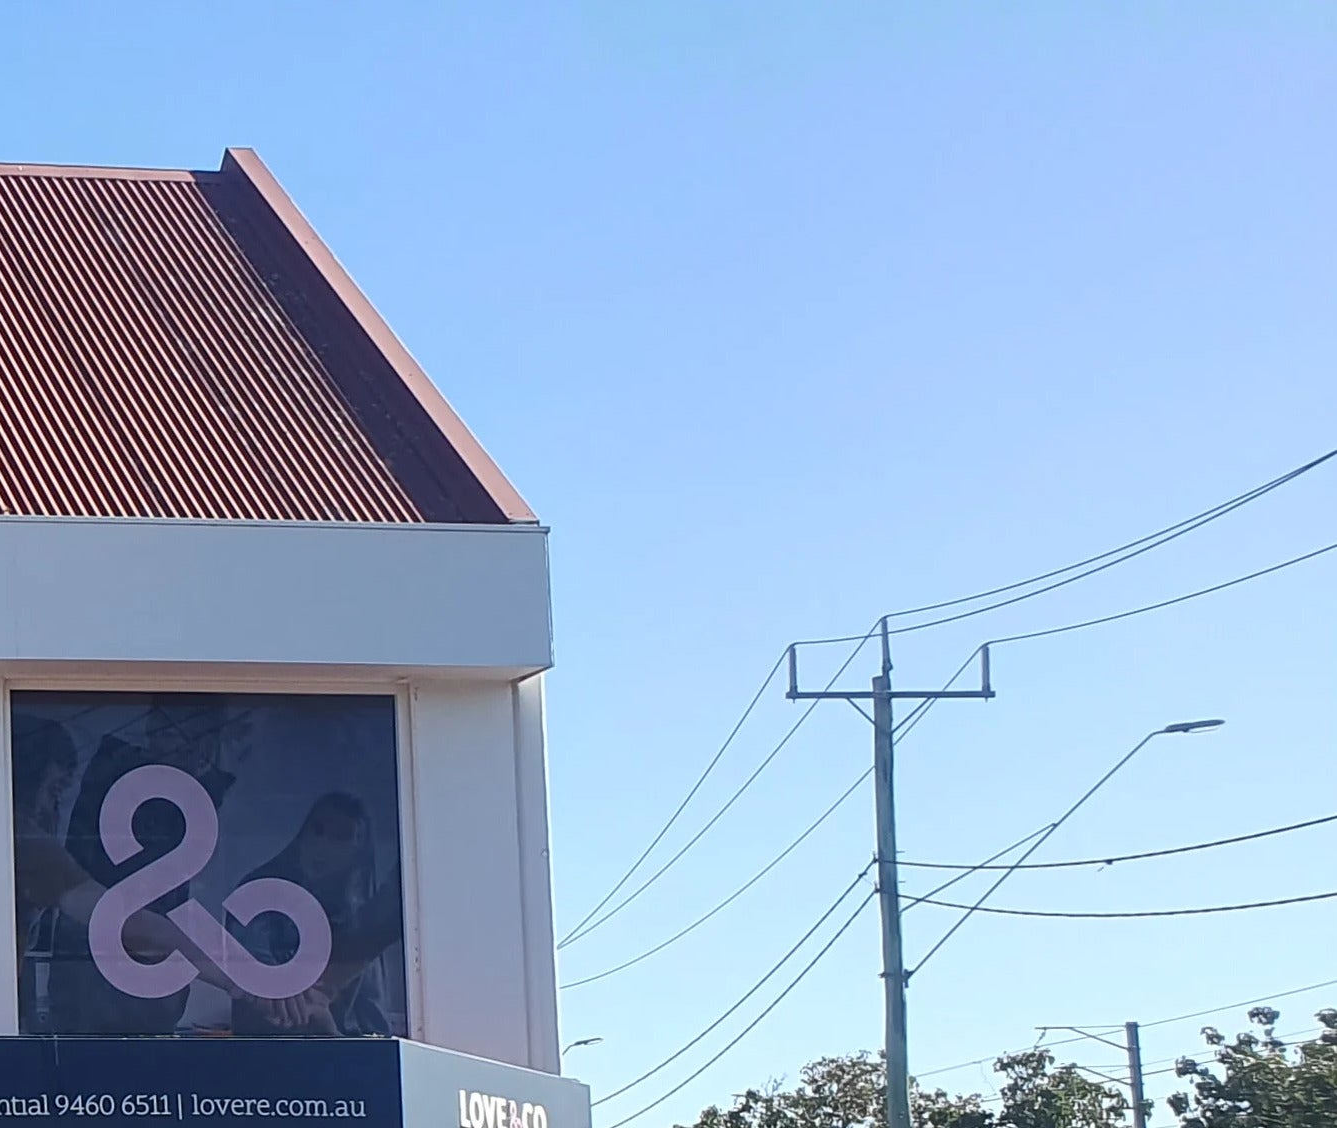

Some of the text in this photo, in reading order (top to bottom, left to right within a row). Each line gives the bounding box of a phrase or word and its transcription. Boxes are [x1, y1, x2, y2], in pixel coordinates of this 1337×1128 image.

[54, 1095, 115, 1116] 9460
[121, 1095, 172, 1116] 6511
[191, 1094, 366, 1118] lovere.com.au
